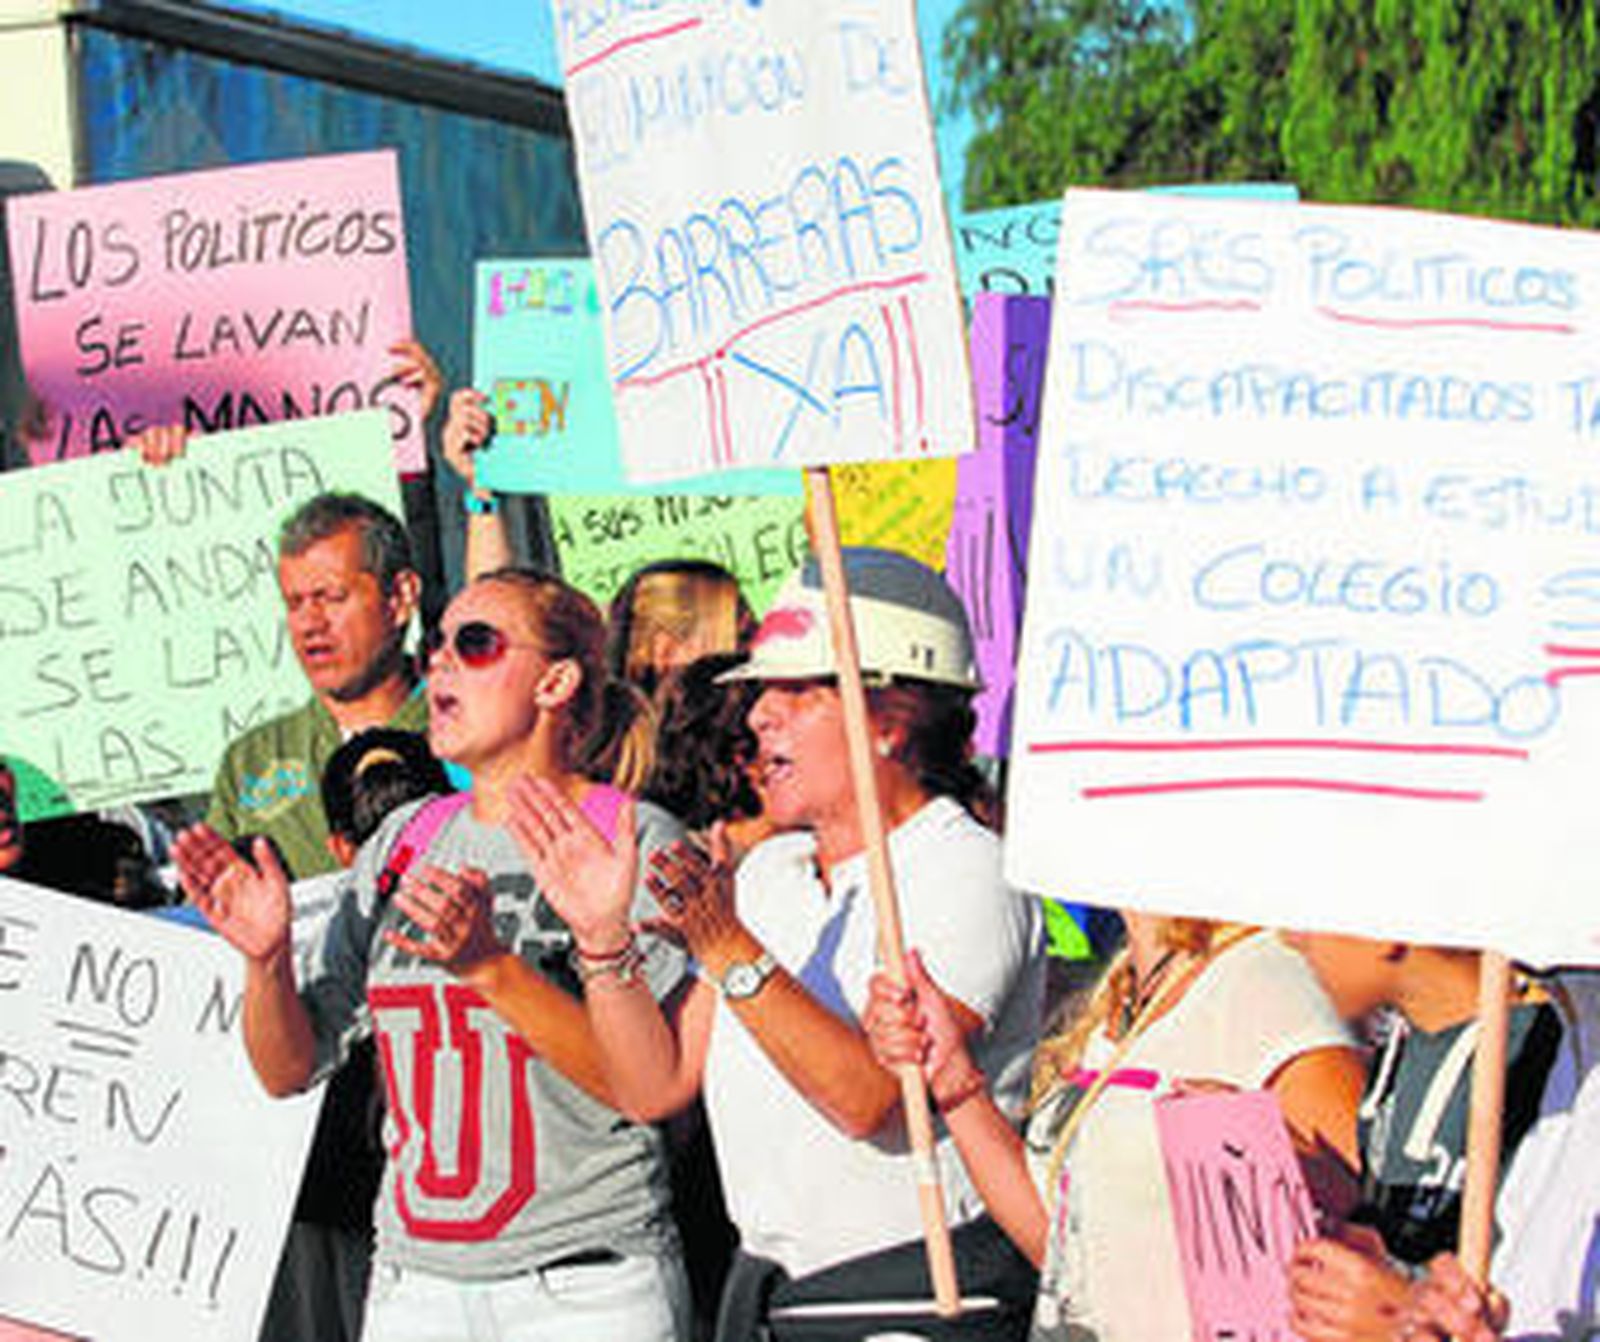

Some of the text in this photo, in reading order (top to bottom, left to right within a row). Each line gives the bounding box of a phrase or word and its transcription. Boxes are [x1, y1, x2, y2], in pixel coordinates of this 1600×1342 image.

[31, 217, 141, 302] LOS
[600, 156, 923, 382] BARRERAS
[1292, 223, 1581, 312] POLITICOS
[76, 303, 371, 377] SE LAVAN
[109, 446, 328, 534] JUNTA
[1361, 463, 1402, 513] A
[1050, 538, 1164, 598] UN
[1192, 542, 1501, 618] COLEGIO
[18, 623, 286, 719] SE LAV
[1044, 626, 1563, 740] ADAPTADO
[55, 720, 188, 788] LAS
[66, 942, 159, 1028] NO
[368, 983, 537, 1243] U
